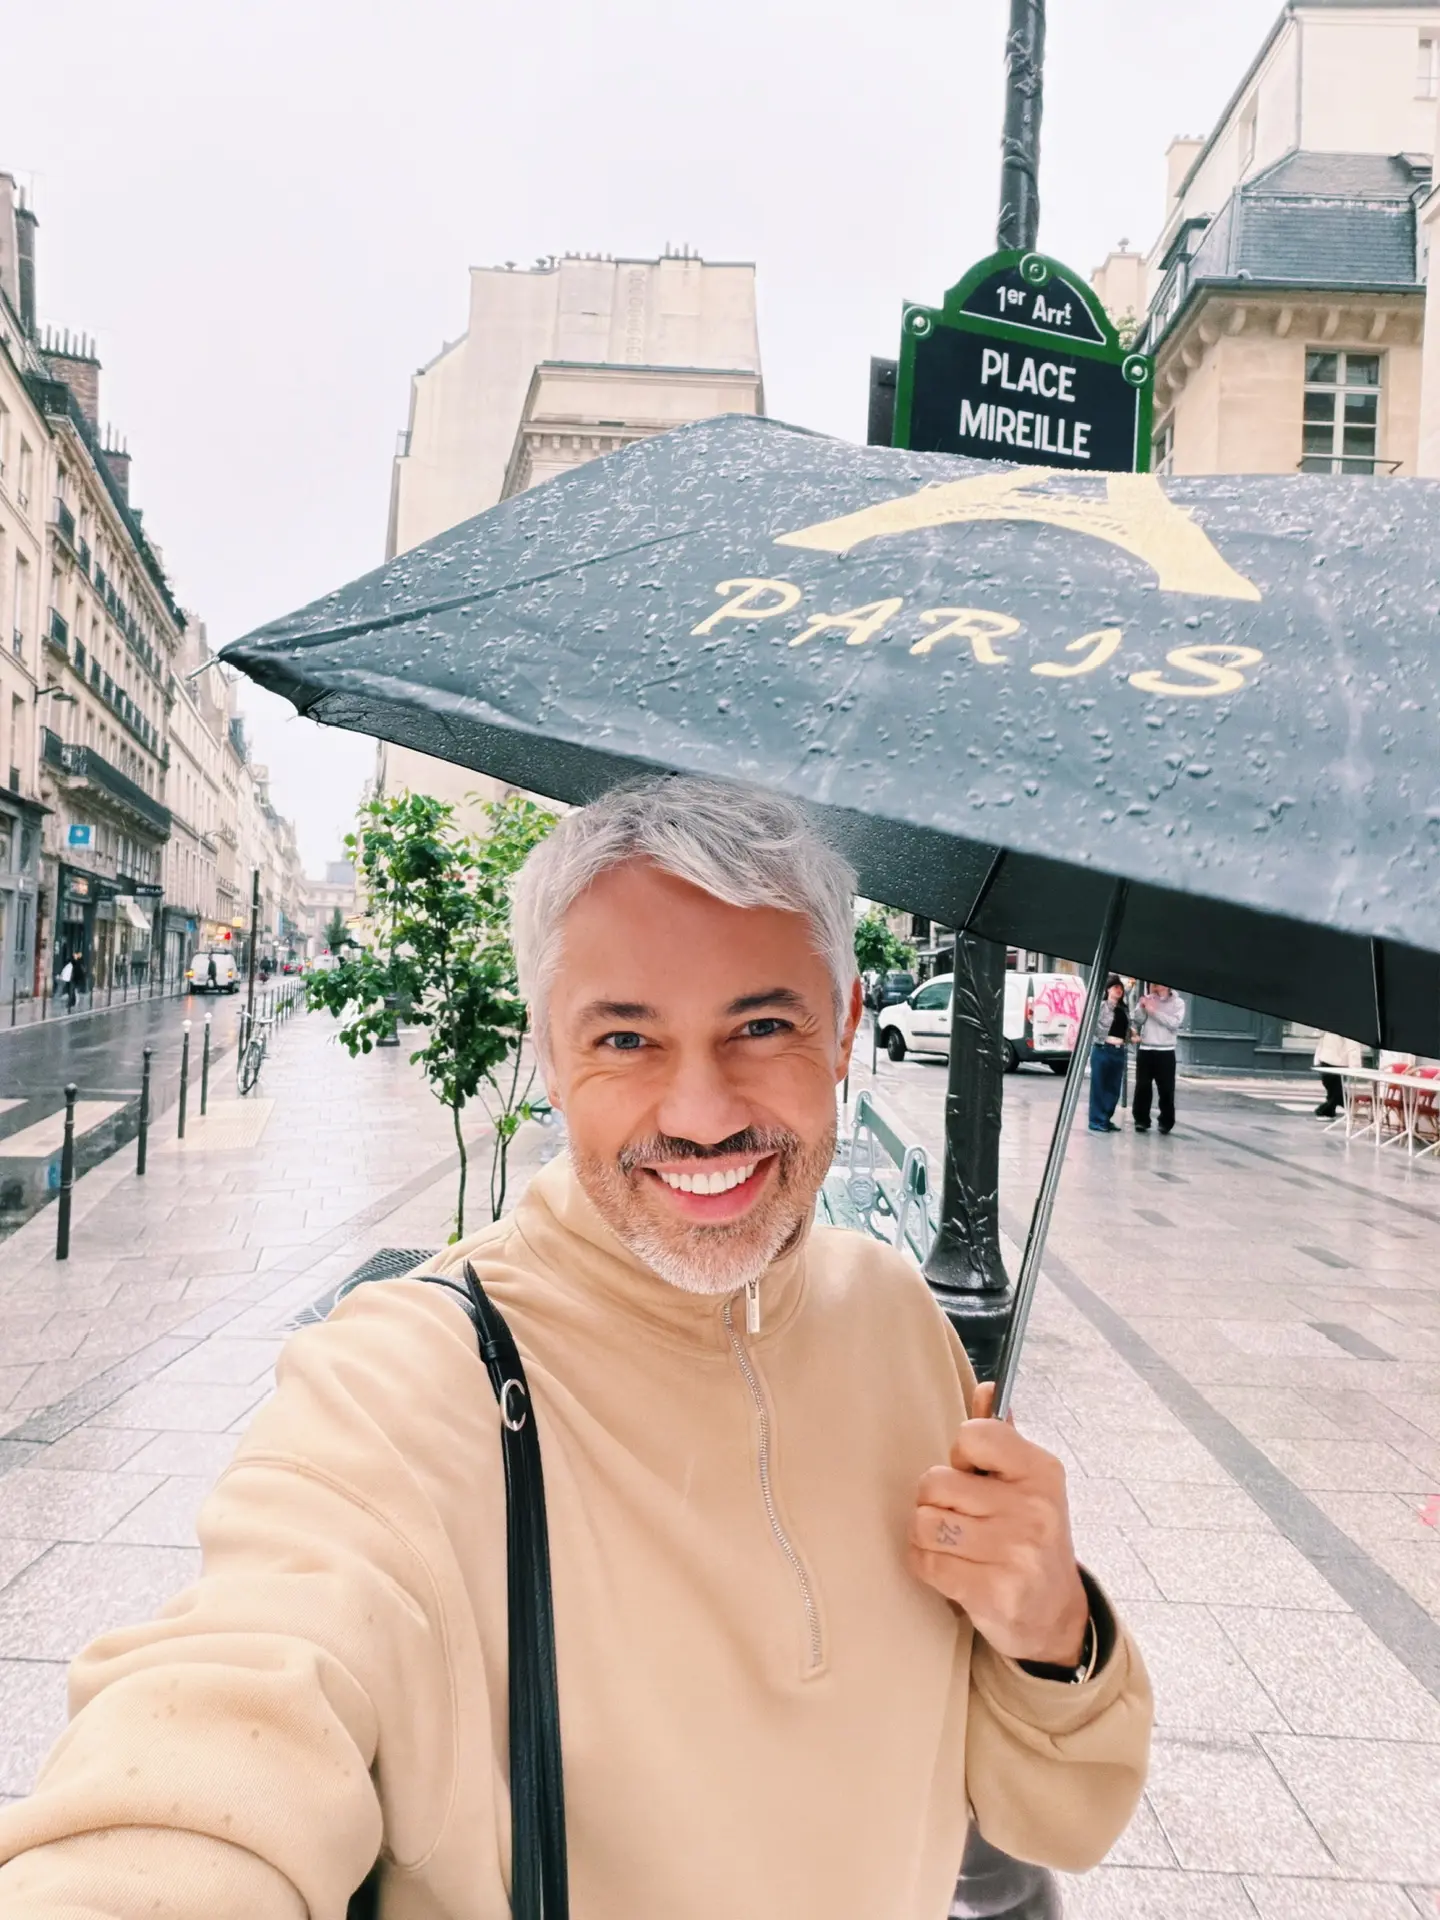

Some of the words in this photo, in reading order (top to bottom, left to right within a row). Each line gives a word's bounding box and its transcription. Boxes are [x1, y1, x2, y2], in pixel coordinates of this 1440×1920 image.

[996, 285, 1027, 312] 1er
[981, 348, 1076, 402] PLACE
[959, 399, 1091, 459] MIREILLE
[690, 577, 1263, 696] PARIS
